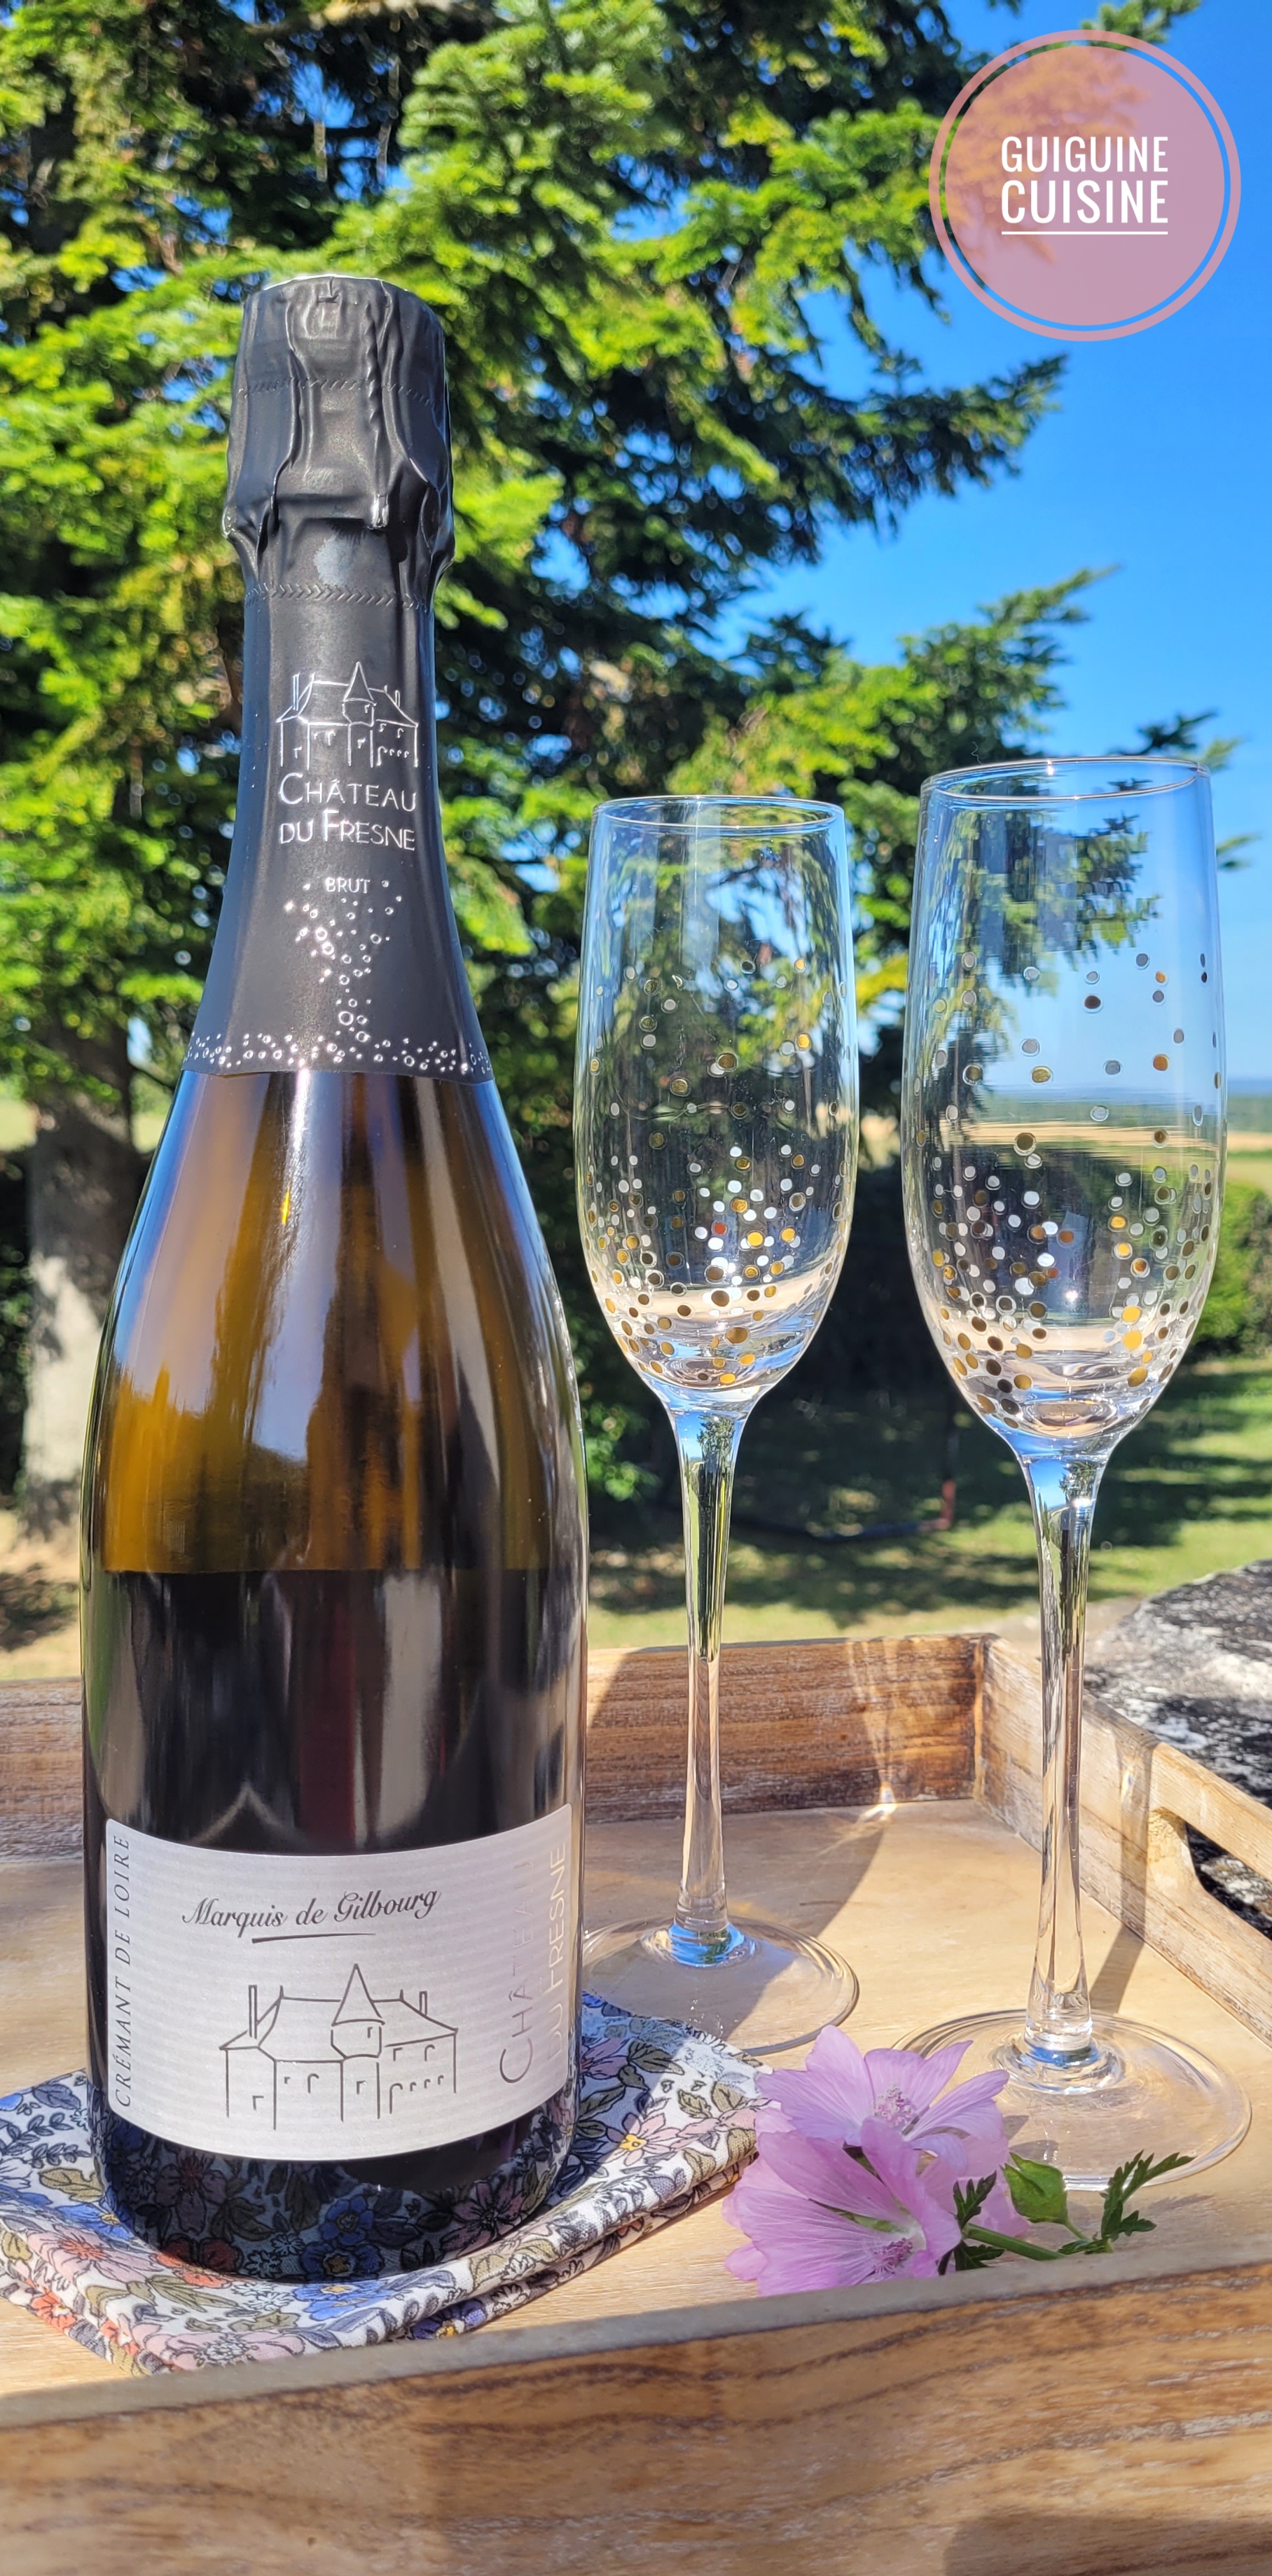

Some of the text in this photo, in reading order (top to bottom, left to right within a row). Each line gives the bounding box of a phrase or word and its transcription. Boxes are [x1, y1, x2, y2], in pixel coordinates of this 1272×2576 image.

[279, 772, 417, 812] CHÂTEAU
[280, 808, 416, 851] DU FRESNE
[326, 878, 371, 894] BRUT
[181, 1889, 441, 1938] Marquis de Gilbourg
[541, 1842, 566, 1997] FRESNE
[111, 1834, 132, 2107] CRÉMANT DE LOIRE
